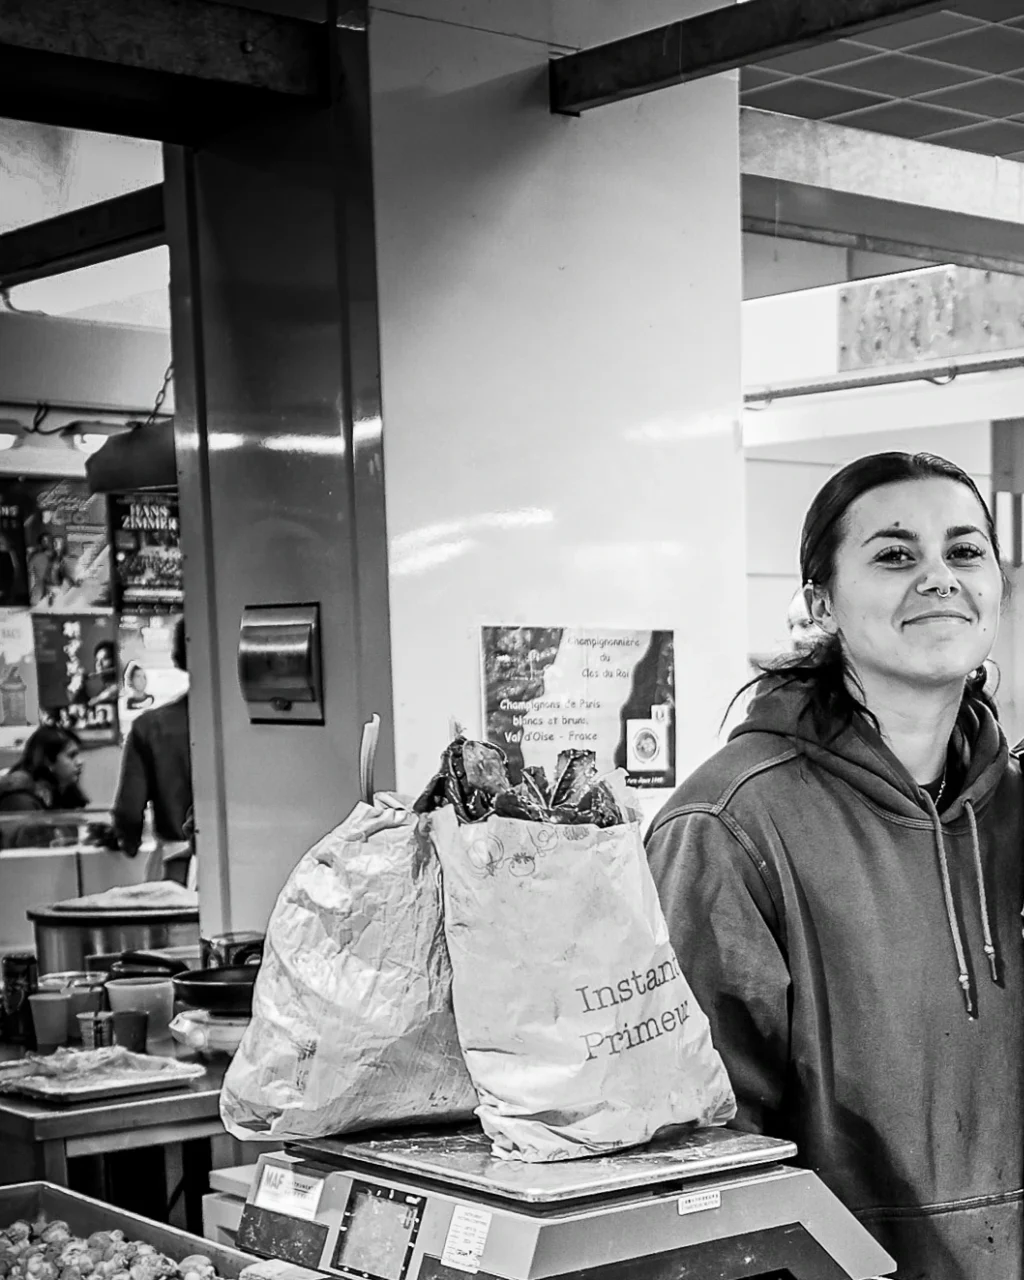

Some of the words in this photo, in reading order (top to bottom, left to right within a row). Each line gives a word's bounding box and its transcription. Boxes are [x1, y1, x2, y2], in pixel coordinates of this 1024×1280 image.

[130, 503, 170, 517] HANS
[599, 652, 611, 662] du
[499, 699, 561, 711] Champignons
[579, 699, 601, 709] Paris
[512, 715, 543, 726] blancs
[504, 731, 522, 743] Val
[524, 730, 554, 741] d'Oise
[265, 1169, 285, 1189] MAF
